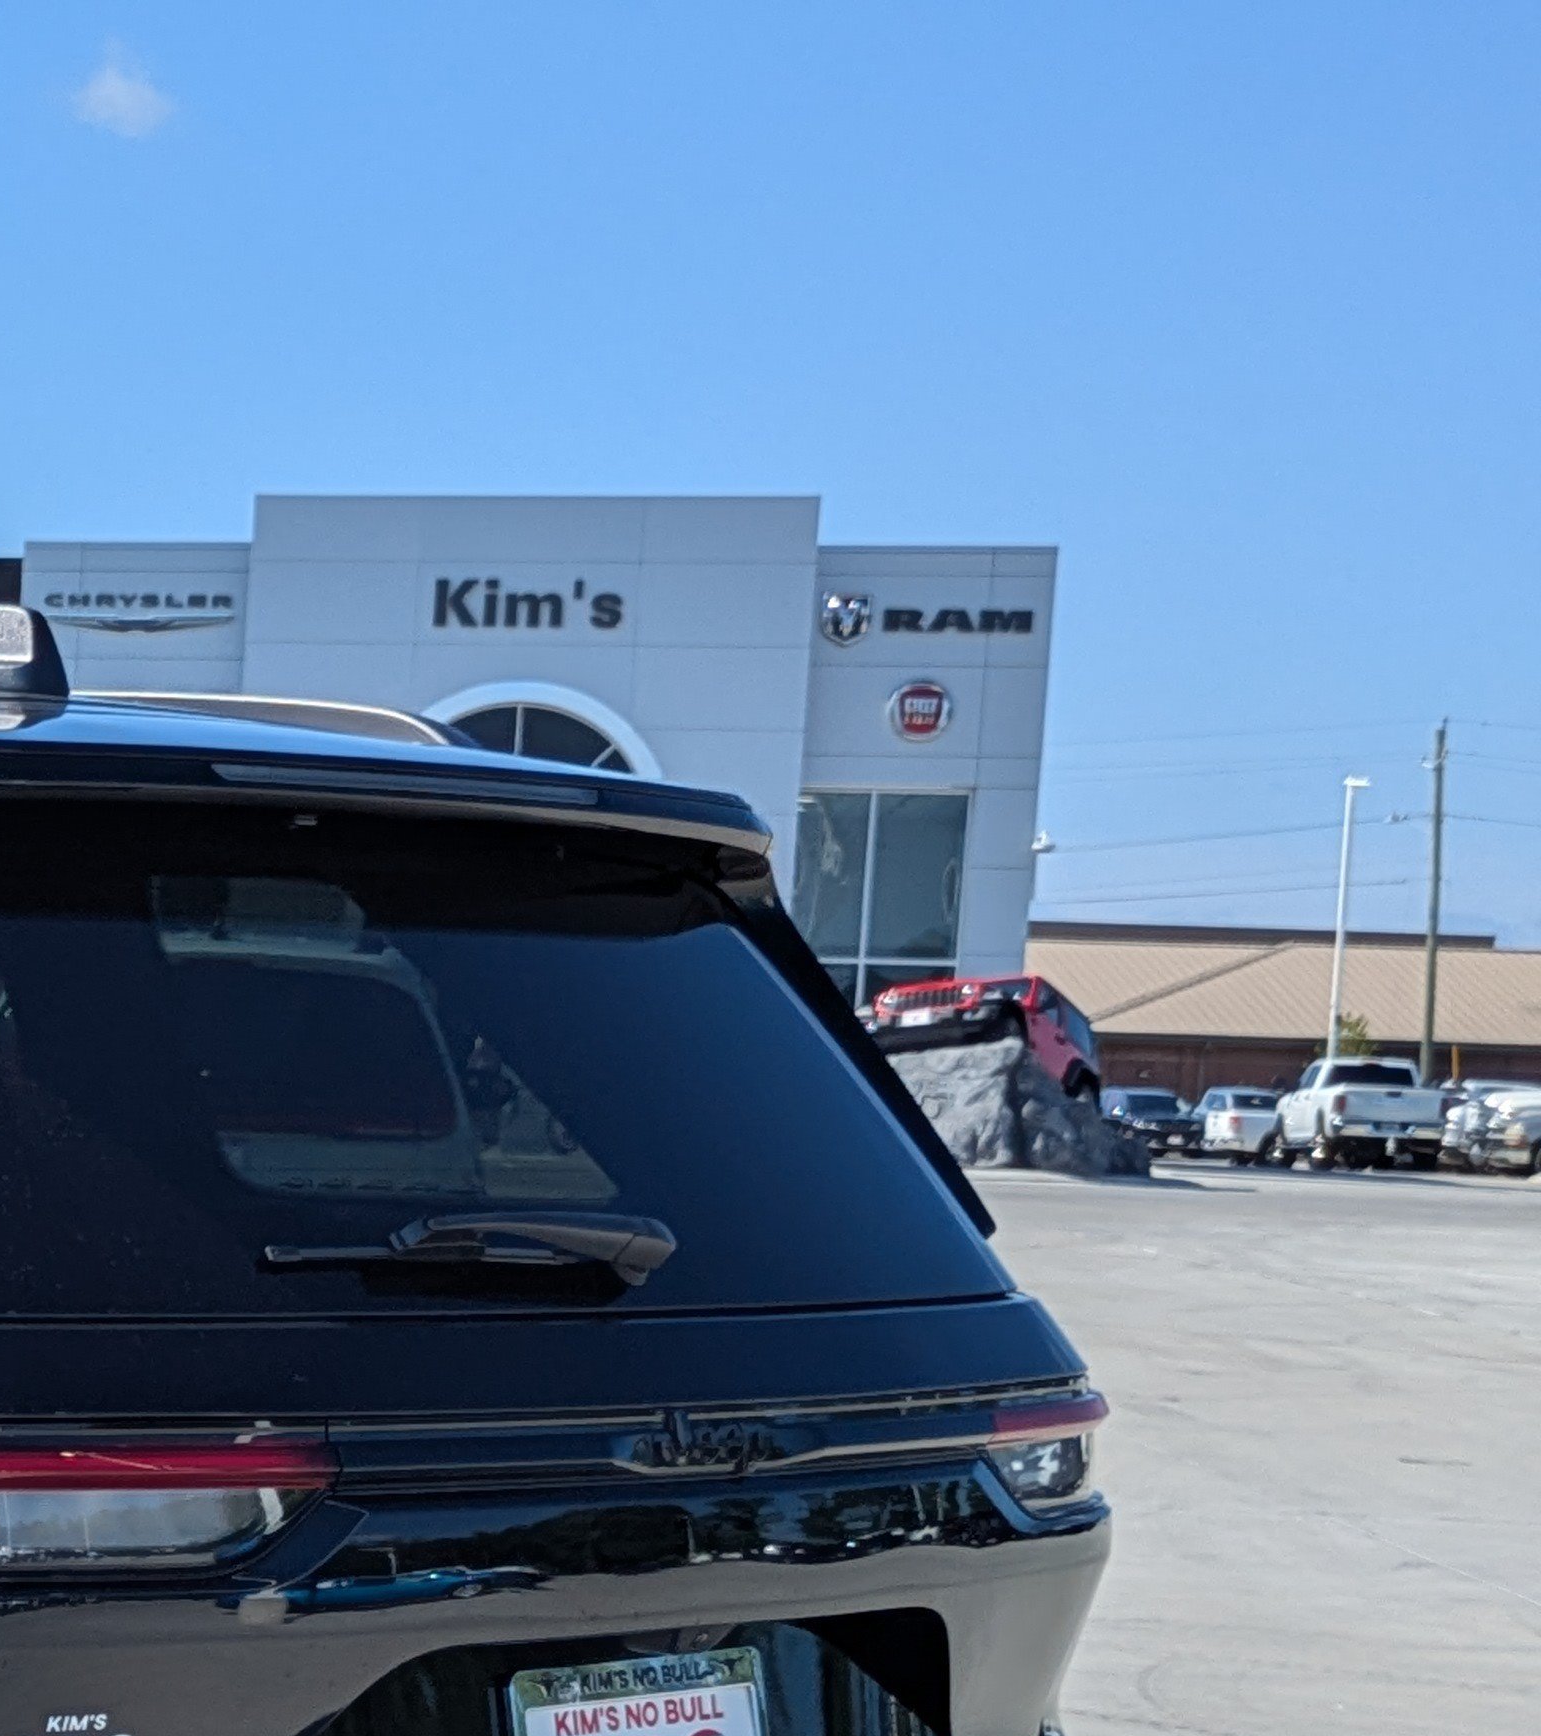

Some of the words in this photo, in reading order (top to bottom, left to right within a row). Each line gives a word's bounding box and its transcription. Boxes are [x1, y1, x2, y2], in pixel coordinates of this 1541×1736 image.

[44, 593, 233, 608] CHRYSLER
[432, 577, 624, 629] Kim's
[882, 609, 1033, 632] RAM
[46, 1714, 108, 1732] KIM'S
[625, 1701, 658, 1729] NO
[664, 1694, 724, 1725] BULL
